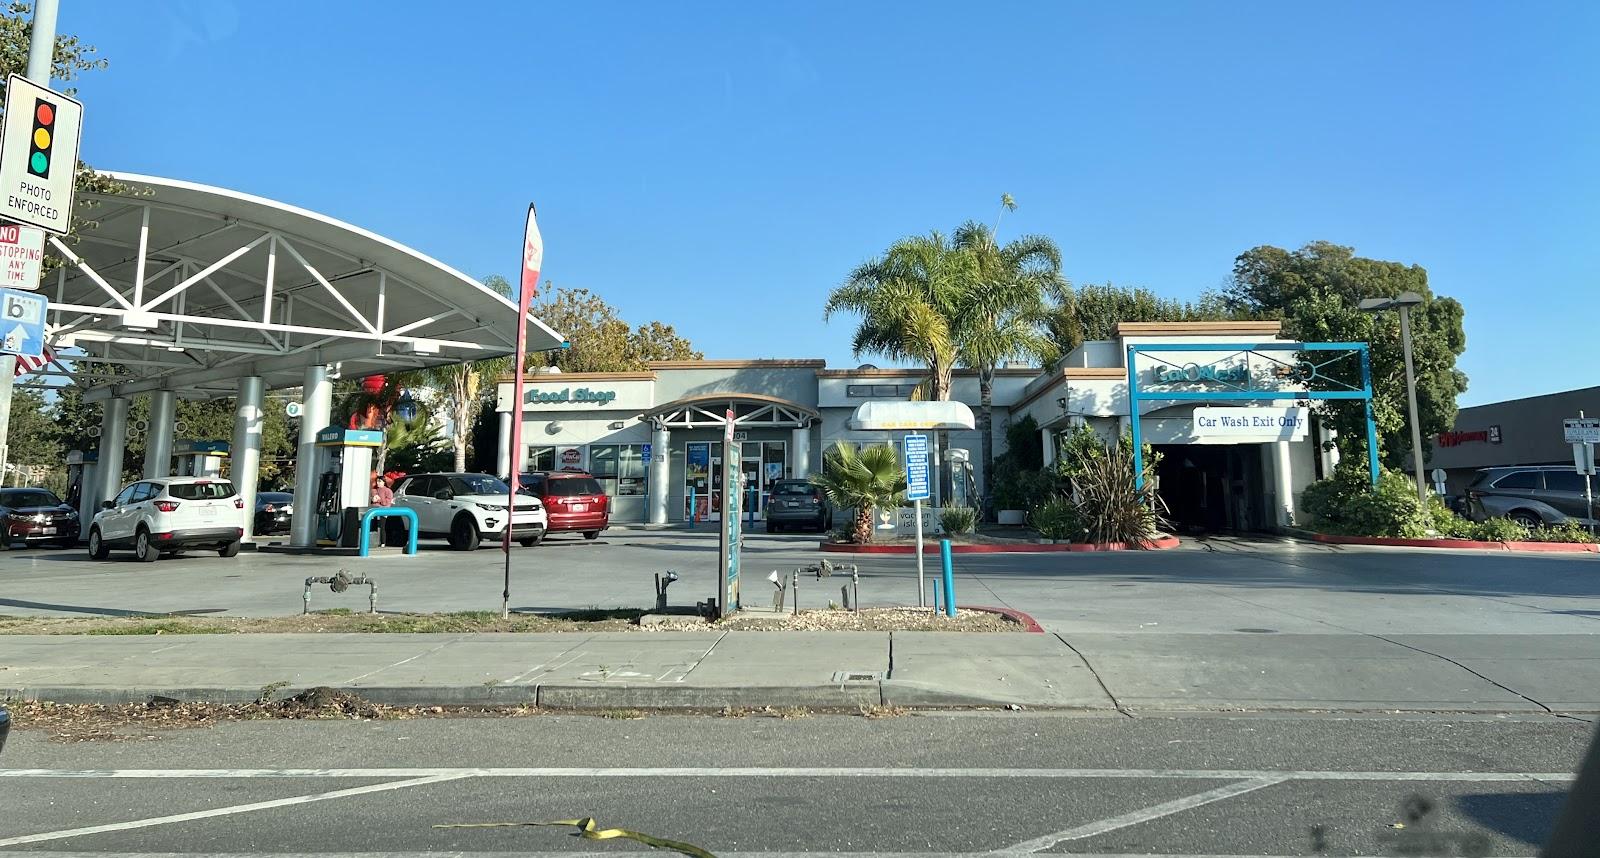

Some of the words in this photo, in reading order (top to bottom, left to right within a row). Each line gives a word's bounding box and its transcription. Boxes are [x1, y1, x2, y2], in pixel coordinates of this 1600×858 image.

[20, 182, 52, 201] PHOTO
[8, 195, 59, 220] ENFORCED
[0, 226, 17, 242] NO
[8, 260, 26, 270] ANY
[7, 270, 26, 281] TIME
[528, 387, 570, 402] Food
[574, 387, 616, 404] Shop
[1198, 416, 1217, 427] Car
[1220, 416, 1249, 427] Wash
[1252, 416, 1275, 427] Exit
[1278, 416, 1304, 430] Only
[1490, 427, 1499, 437] 24
[900, 512, 932, 520] vacm
